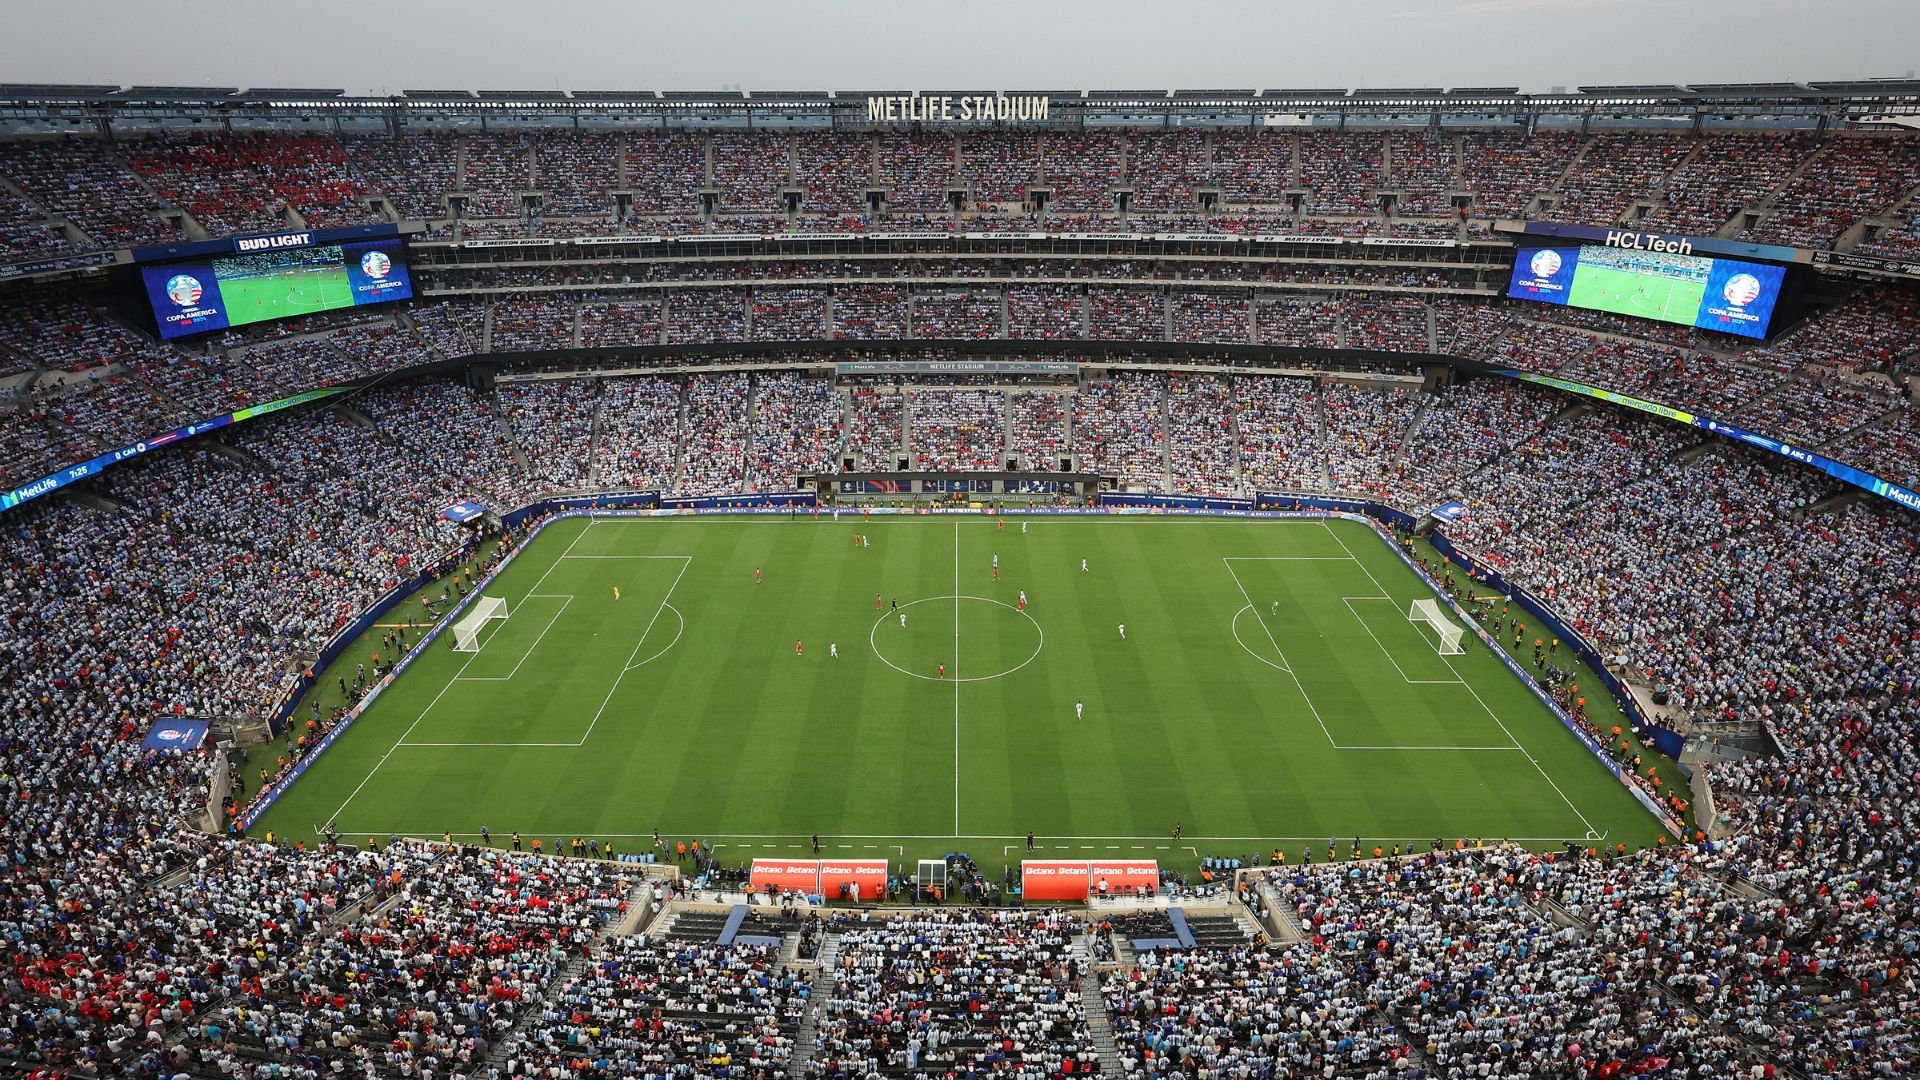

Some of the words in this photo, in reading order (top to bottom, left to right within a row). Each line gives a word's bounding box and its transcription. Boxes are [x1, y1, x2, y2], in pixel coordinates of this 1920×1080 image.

[868, 97, 952, 120] METLIFE
[960, 96, 1048, 120] STADIUM
[238, 238, 270, 251] BUD
[270, 234, 310, 248] LIGHT
[1605, 230, 1692, 254] HCLTech
[186, 309, 217, 318] AMERICA
[1709, 308, 1726, 316] COPA
[1728, 311, 1759, 321] AMERICA
[1542, 378, 1576, 391] mercado
[1577, 384, 1594, 395] libre
[267, 396, 301, 410] mercado
[1622, 398, 1657, 413] mercado
[1658, 407, 1677, 418] libre
[1790, 450, 1804, 459] ARG
[69, 466, 87, 478] 7:25
[19, 478, 57, 500] MetLife
[1493, 645, 1506, 658] LATAM
[1531, 684, 1546, 699] LATAM
[1553, 705, 1566, 720] DELTA
[334, 720, 349, 736] DELTA
[1575, 730, 1592, 747] LATAM
[308, 742, 326, 762] LATAM
[1602, 754, 1616, 772] DELTA
[281, 771, 298, 789] DELTA
[251, 797, 271, 820] LATAM
